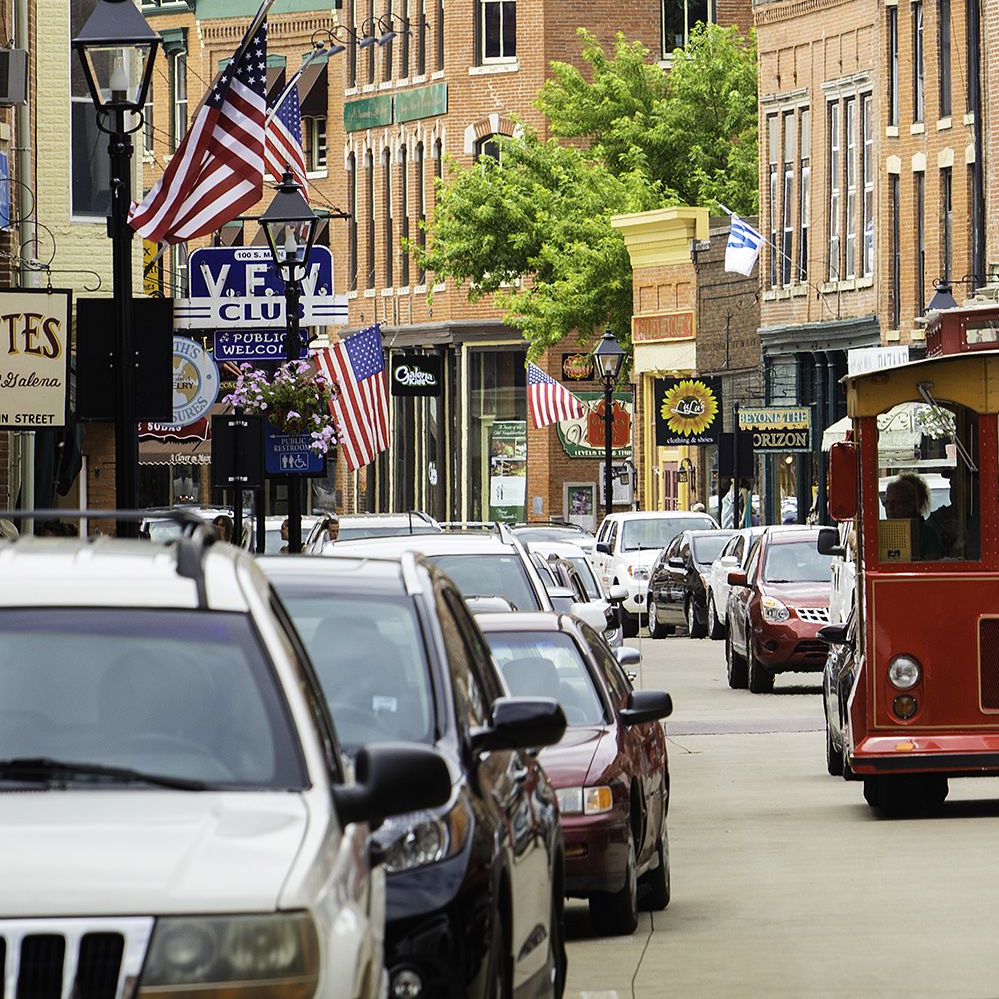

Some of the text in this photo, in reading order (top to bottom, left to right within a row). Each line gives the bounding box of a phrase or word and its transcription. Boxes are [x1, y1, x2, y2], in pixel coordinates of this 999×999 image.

[1, 371, 62, 388] Galena
[15, 414, 55, 424] STREET
[739, 412, 807, 424] BEYOND THE
[666, 437, 690, 445] clothing
[753, 432, 807, 447] ORIZON
